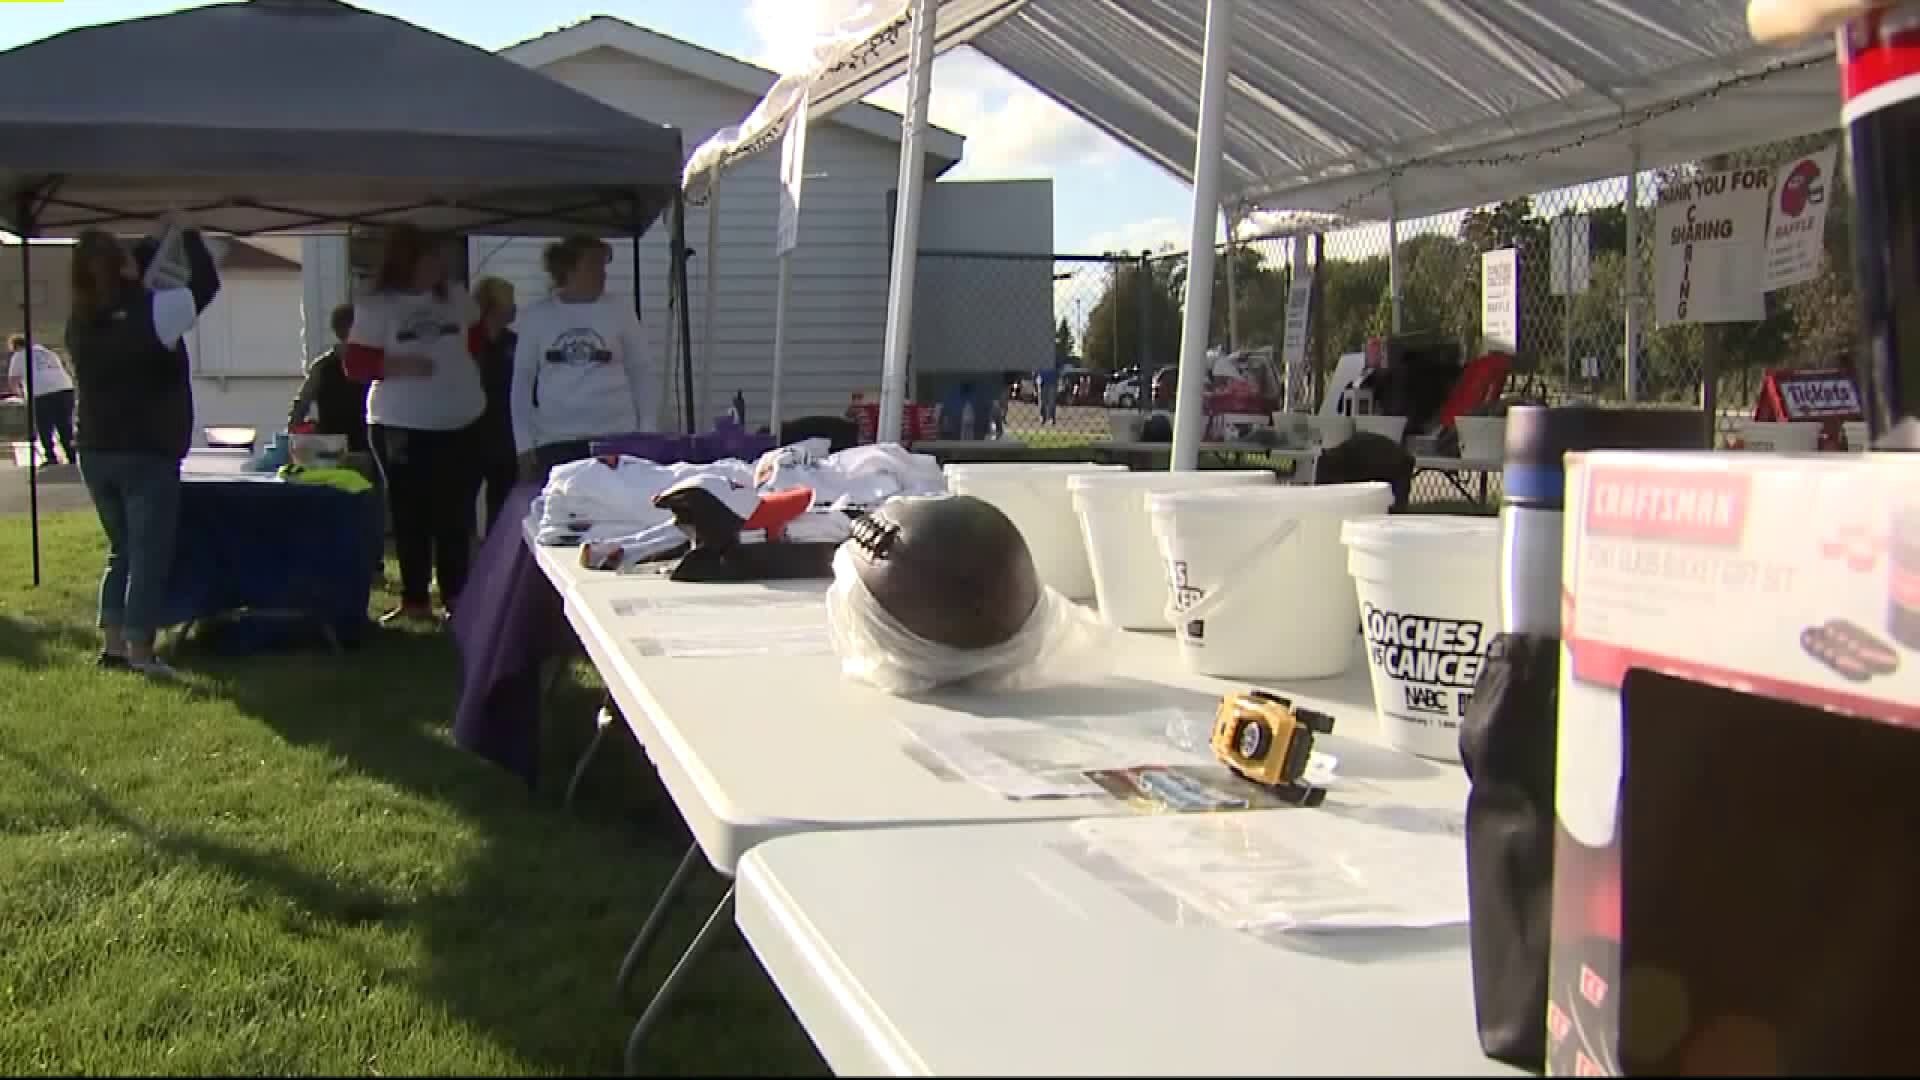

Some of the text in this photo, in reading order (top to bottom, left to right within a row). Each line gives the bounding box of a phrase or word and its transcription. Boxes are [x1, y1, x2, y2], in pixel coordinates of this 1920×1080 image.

[1694, 175, 1726, 201] YOU
[1730, 168, 1769, 191] FOR
[1671, 219, 1734, 245] SHARING
[1593, 481, 1734, 529] CRAFTSMAN
[1362, 601, 1484, 655] COACHES
[1404, 686, 1449, 707] NABC
